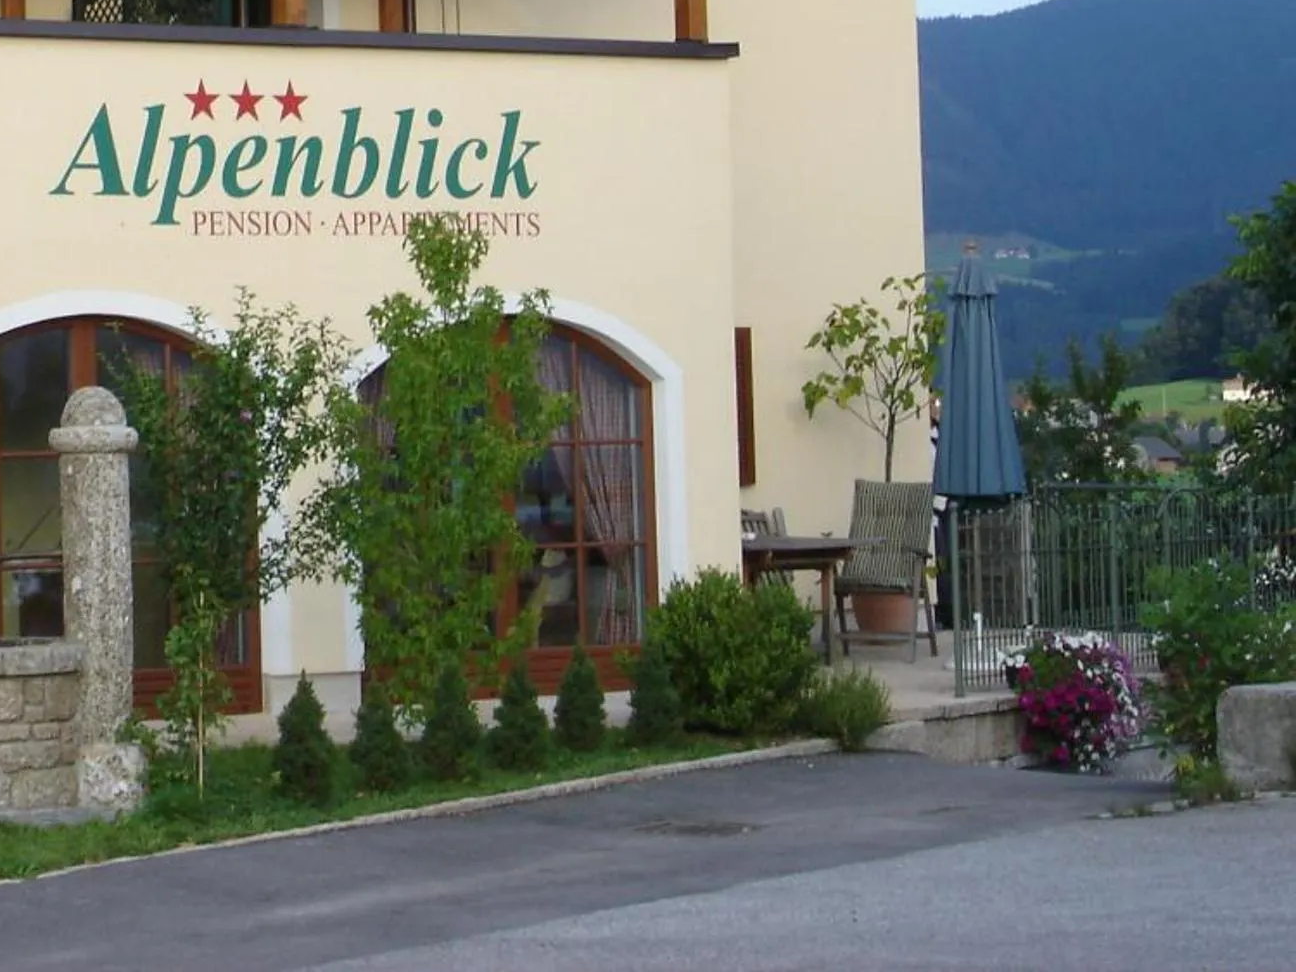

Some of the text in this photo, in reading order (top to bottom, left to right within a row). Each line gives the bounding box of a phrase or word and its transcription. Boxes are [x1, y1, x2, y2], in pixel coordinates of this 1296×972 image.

[48, 101, 541, 226] Alpenblick
[192, 209, 541, 237] PENSION APPARTMENTS
